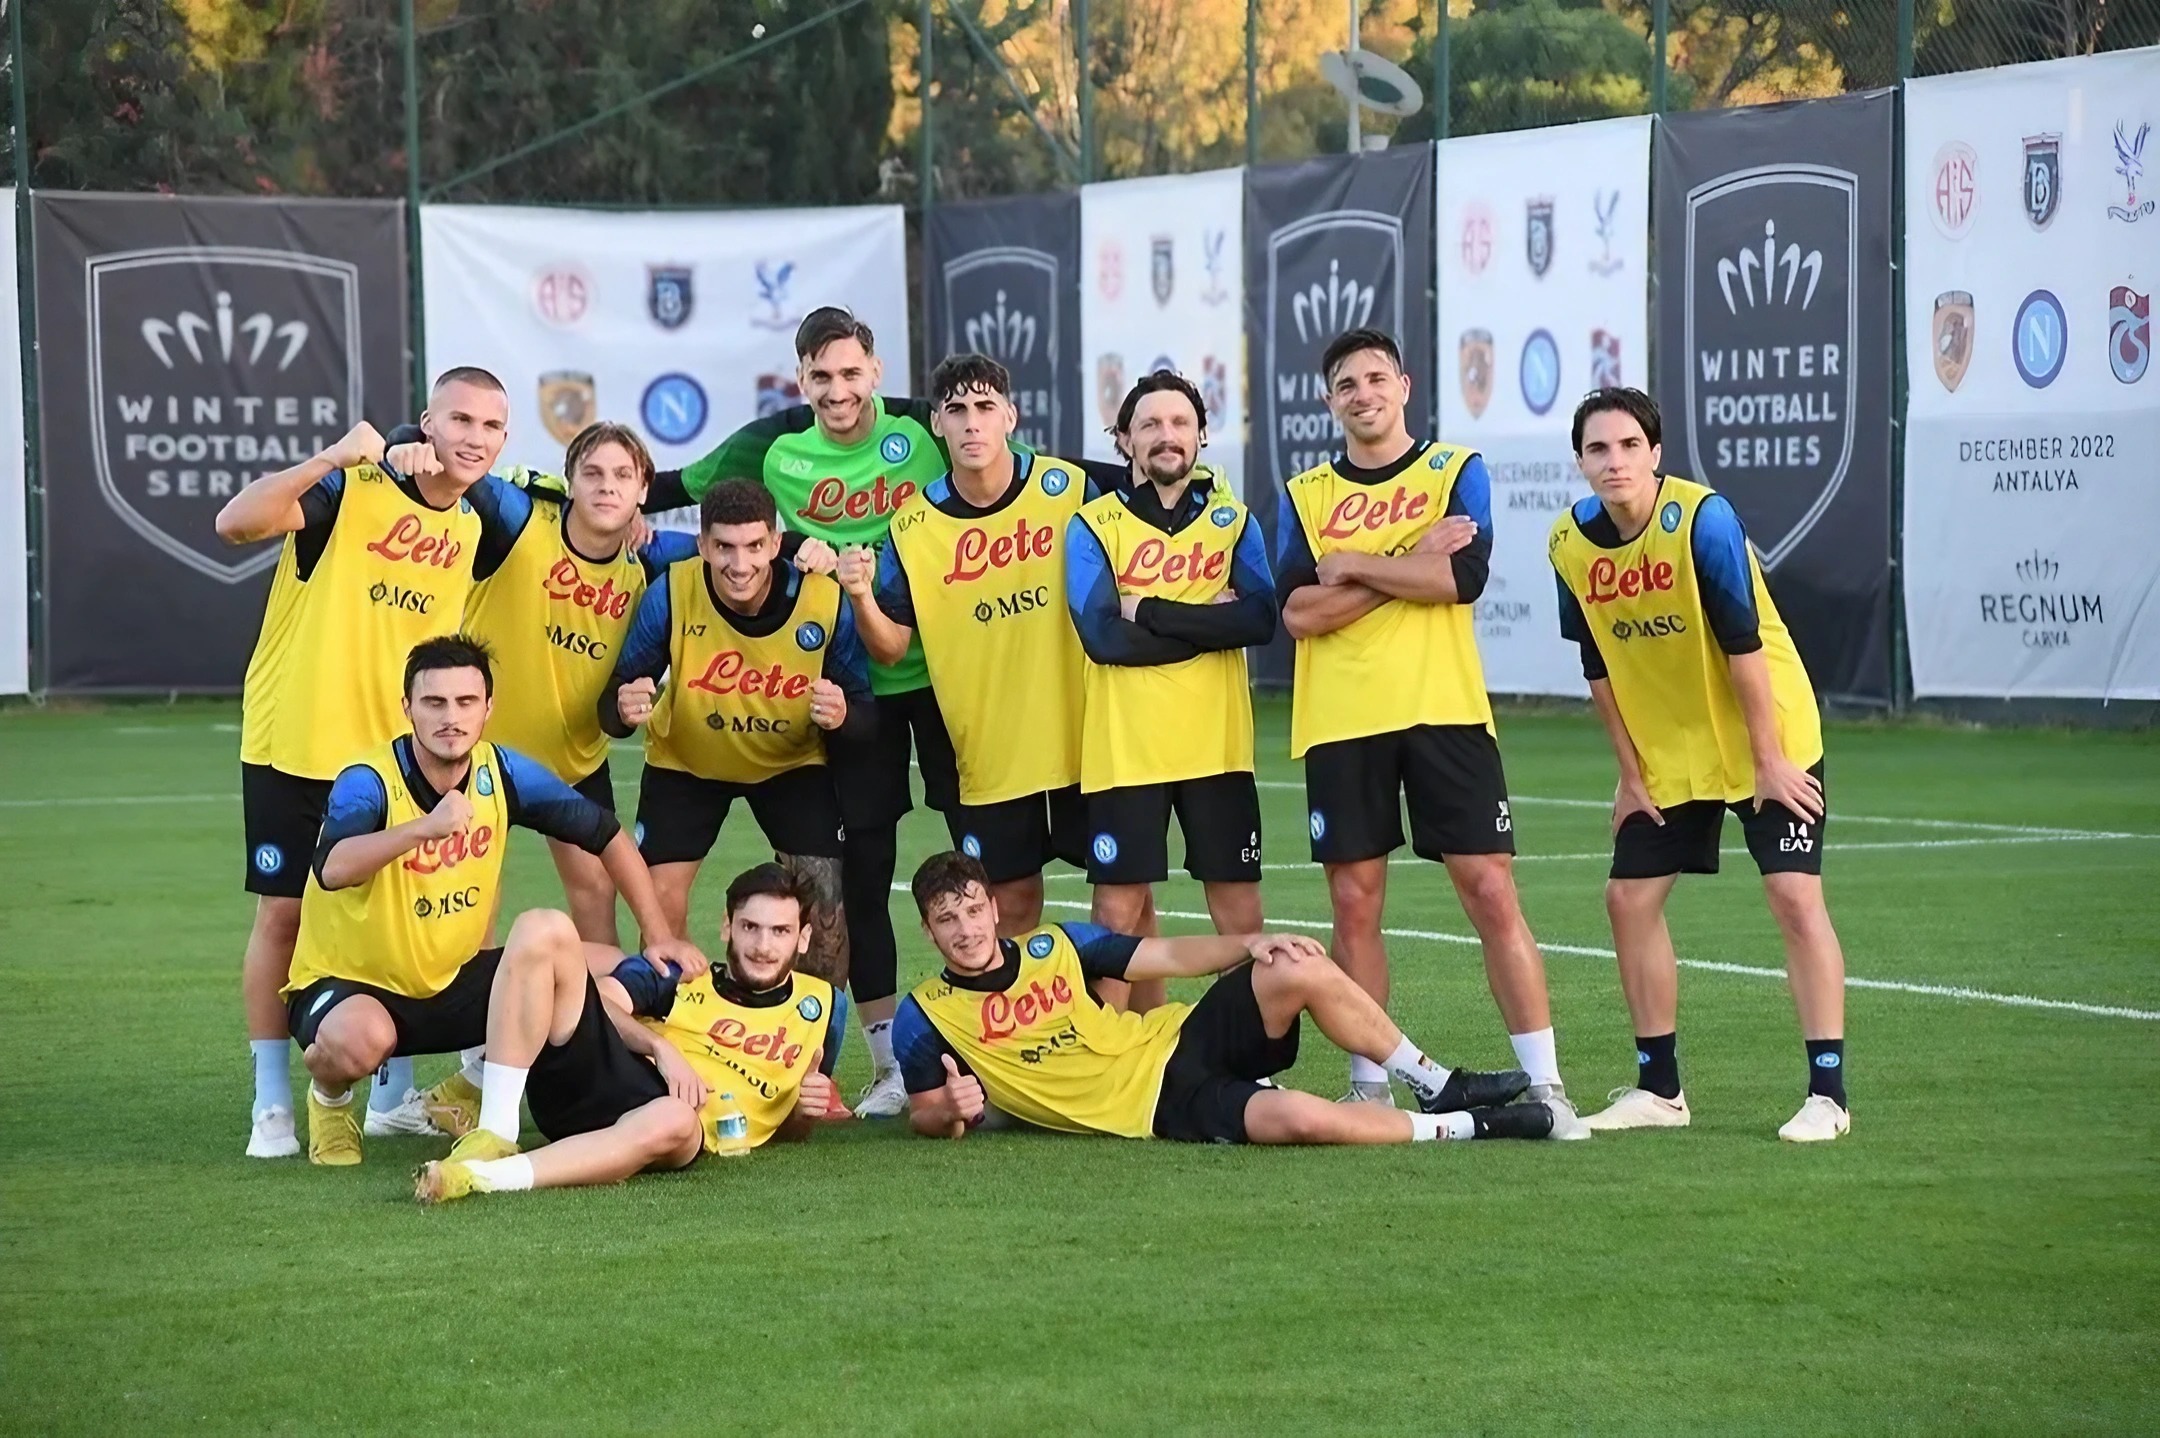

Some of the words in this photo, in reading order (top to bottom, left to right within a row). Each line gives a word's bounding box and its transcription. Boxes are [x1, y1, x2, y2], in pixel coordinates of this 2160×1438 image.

[1701, 343, 1840, 382] WINTER
[117, 394, 338, 426] WINTER
[1705, 391, 1838, 426] FOOTBALL
[1716, 435, 1821, 468] SERIES
[1959, 437, 2063, 462] DECEMBER
[2070, 434, 2115, 458] 2022
[1992, 468, 2079, 493] ANTALYA
[796, 475, 917, 525] Lete
[1320, 486, 1429, 539] Lete
[1509, 490, 1572, 511] ANTALYA
[897, 510, 926, 533] EA7
[366, 514, 461, 569] Lete
[944, 518, 1054, 585] Lete
[1117, 538, 1226, 587] Lete
[1585, 553, 1674, 604] Lete
[542, 557, 631, 620] Lete
[997, 586, 1049, 618] MSC
[1979, 593, 2104, 624] REGNUM
[551, 625, 608, 660] MSC
[1636, 615, 1687, 638] MSC
[688, 651, 810, 699] Lete
[731, 715, 791, 734] MSC
[1780, 838, 1814, 853] EA7
[1788, 822, 1808, 838] 14
[979, 975, 1072, 1043] Lete
[707, 1018, 802, 1068] Lete
